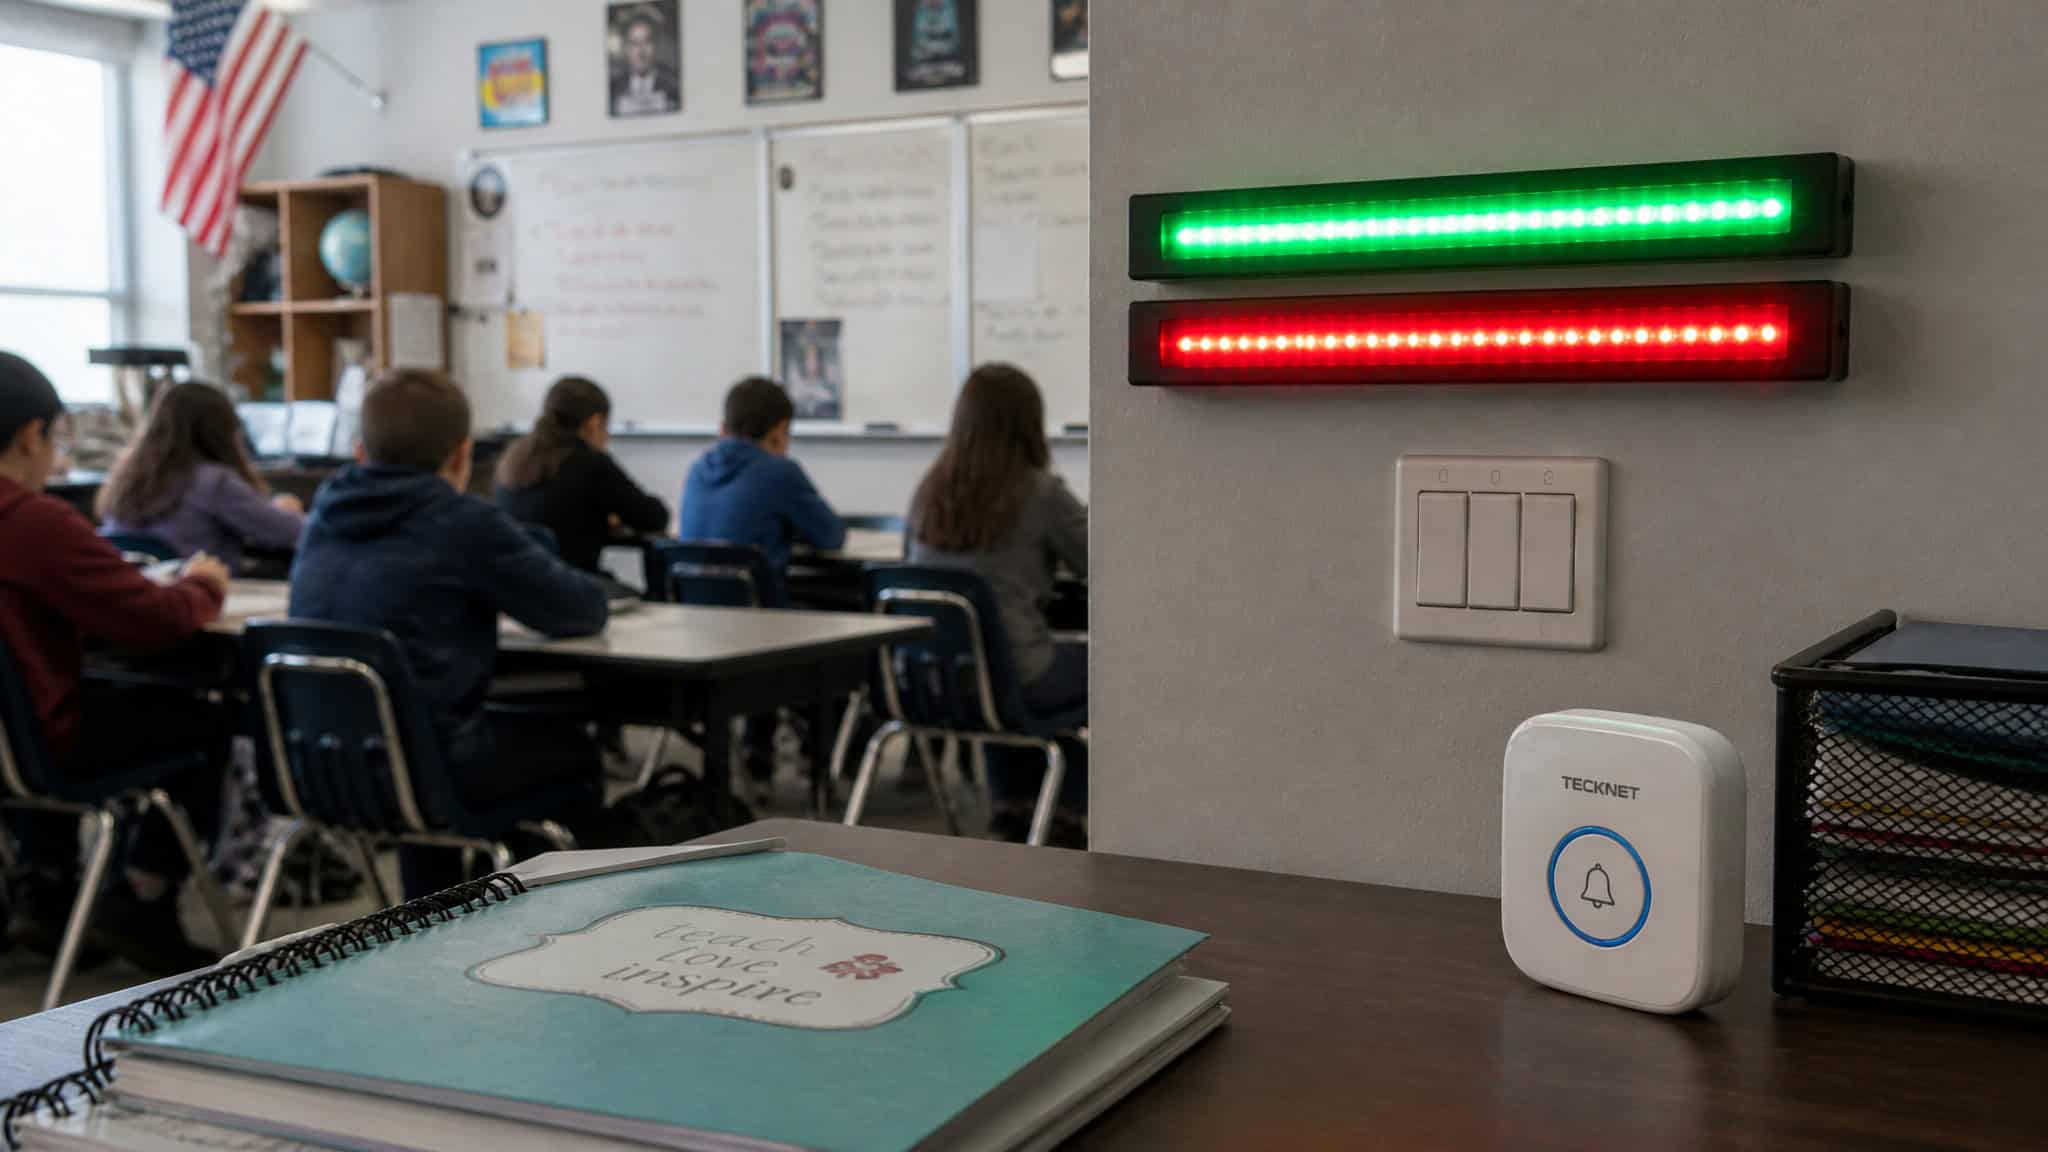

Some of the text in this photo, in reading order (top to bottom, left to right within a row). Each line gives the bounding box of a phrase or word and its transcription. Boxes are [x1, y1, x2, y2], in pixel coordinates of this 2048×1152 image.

[1561, 775, 1640, 800] TECKNET
[654, 923, 815, 955] teach
[656, 946, 778, 973] love
[602, 962, 821, 1005] inspire
